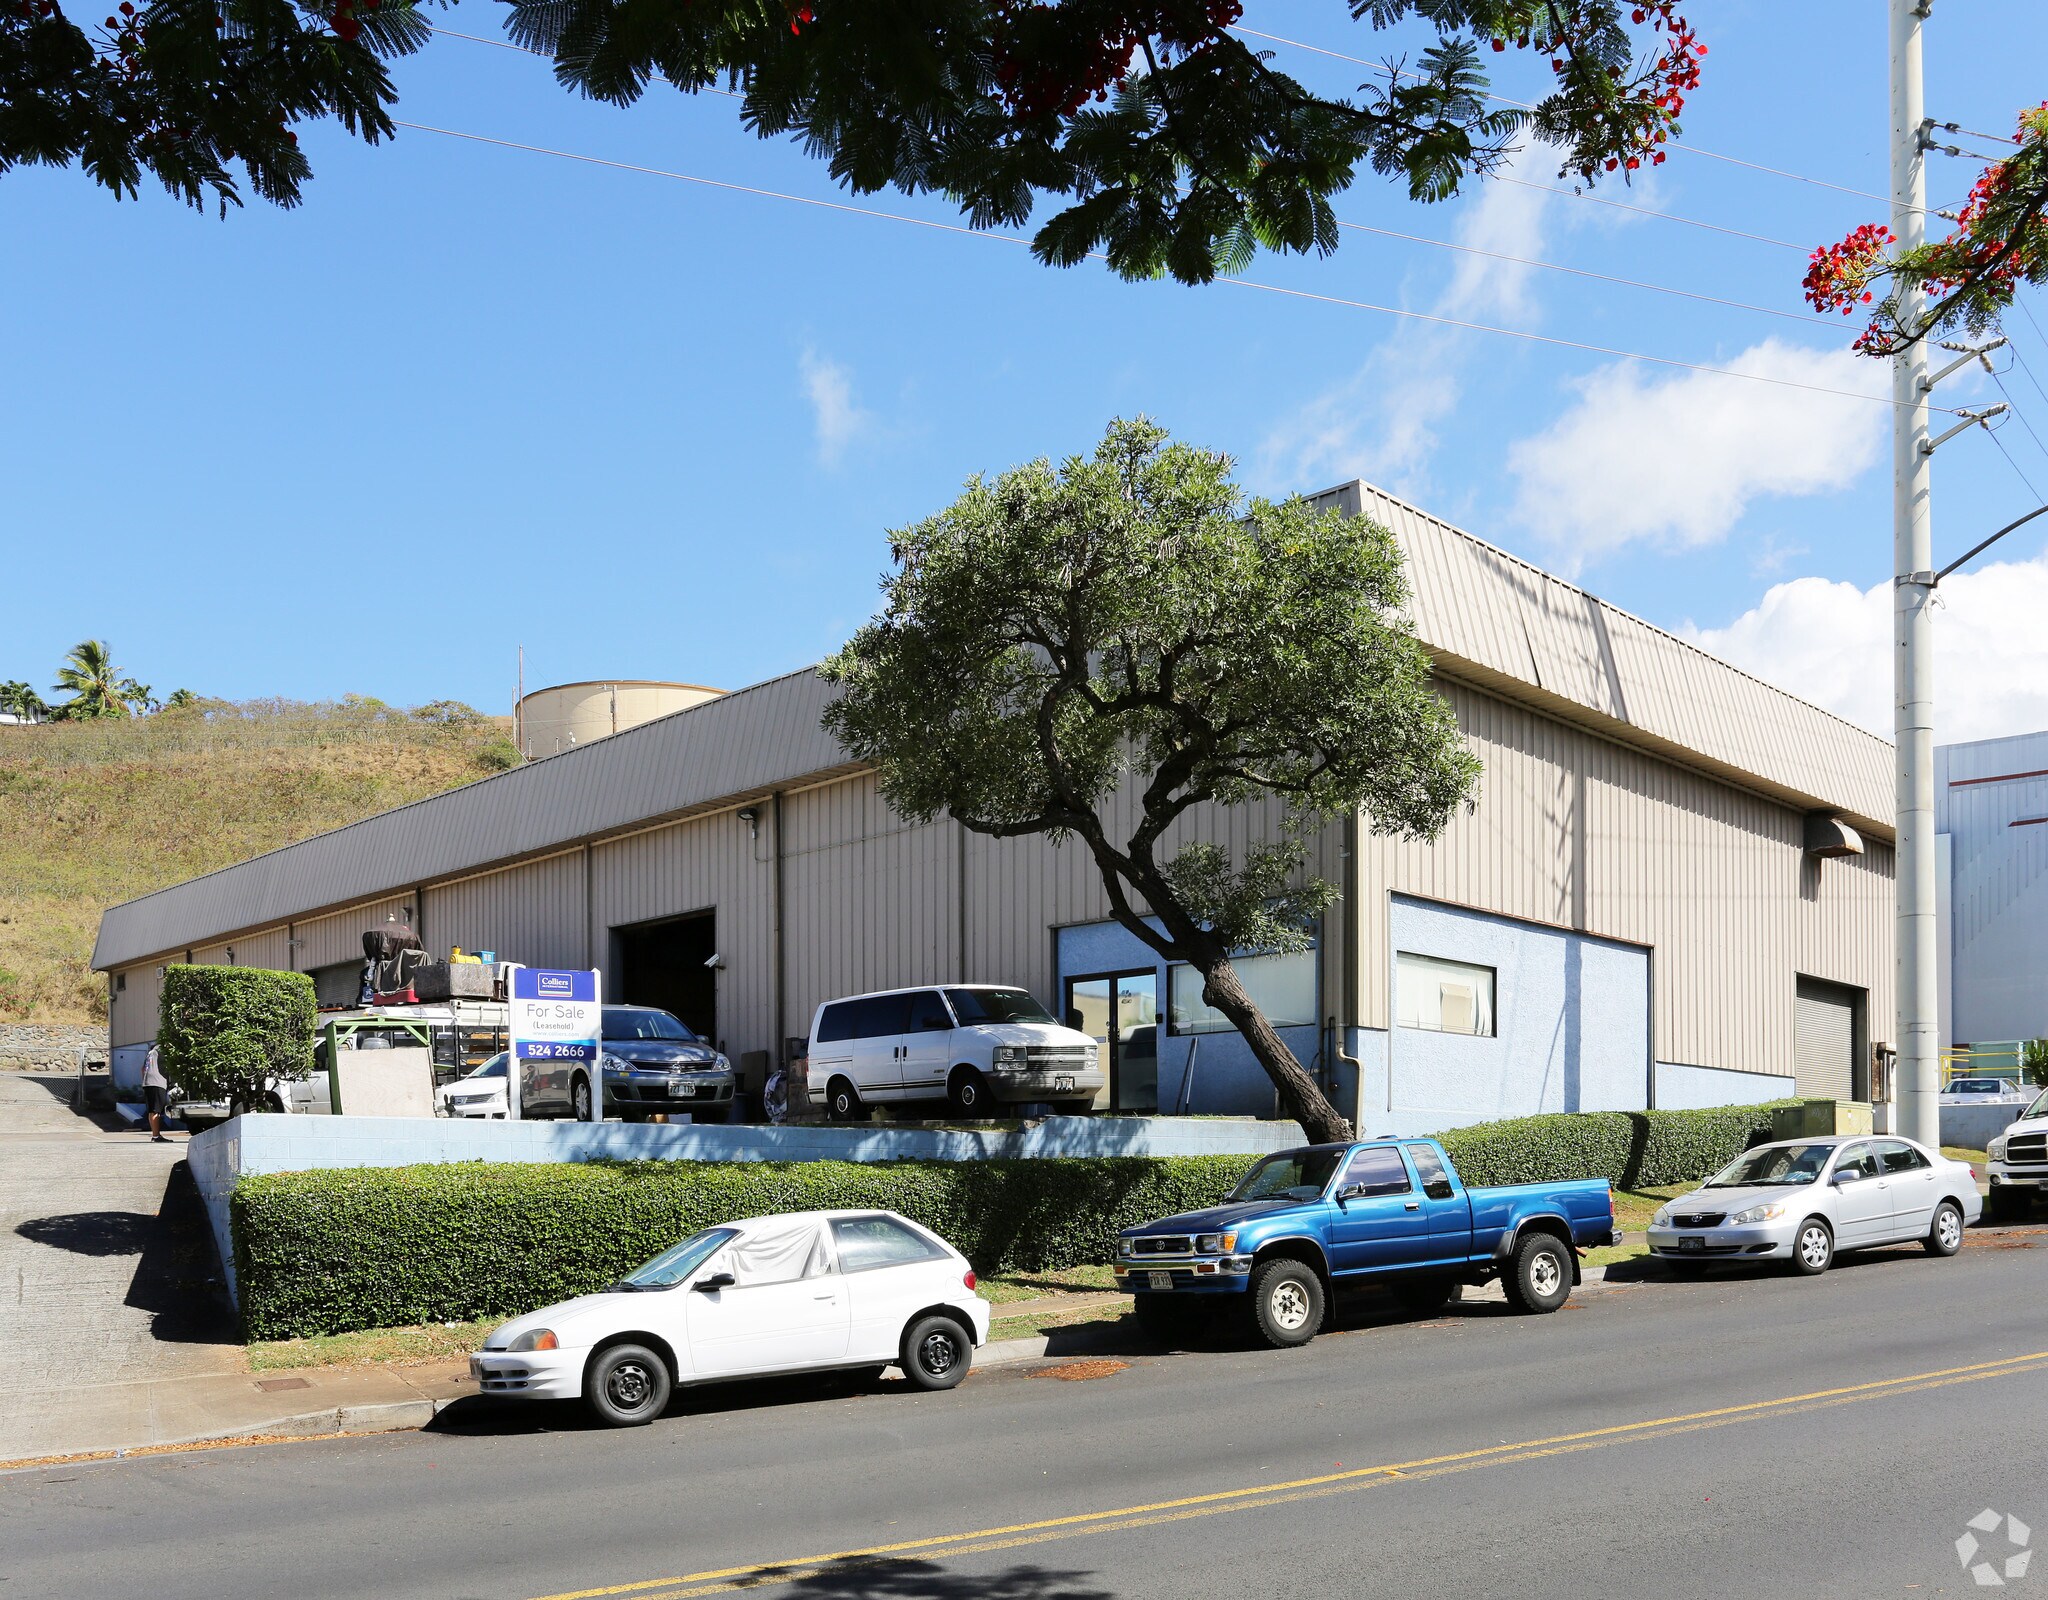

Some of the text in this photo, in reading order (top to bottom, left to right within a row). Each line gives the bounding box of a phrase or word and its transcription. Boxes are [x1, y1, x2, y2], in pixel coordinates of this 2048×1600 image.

[542, 977, 569, 986] Colliers
[527, 1003, 585, 1019] For Sale
[532, 1021, 575, 1031] (Leasehold)
[528, 1044, 585, 1057] 524 2666
